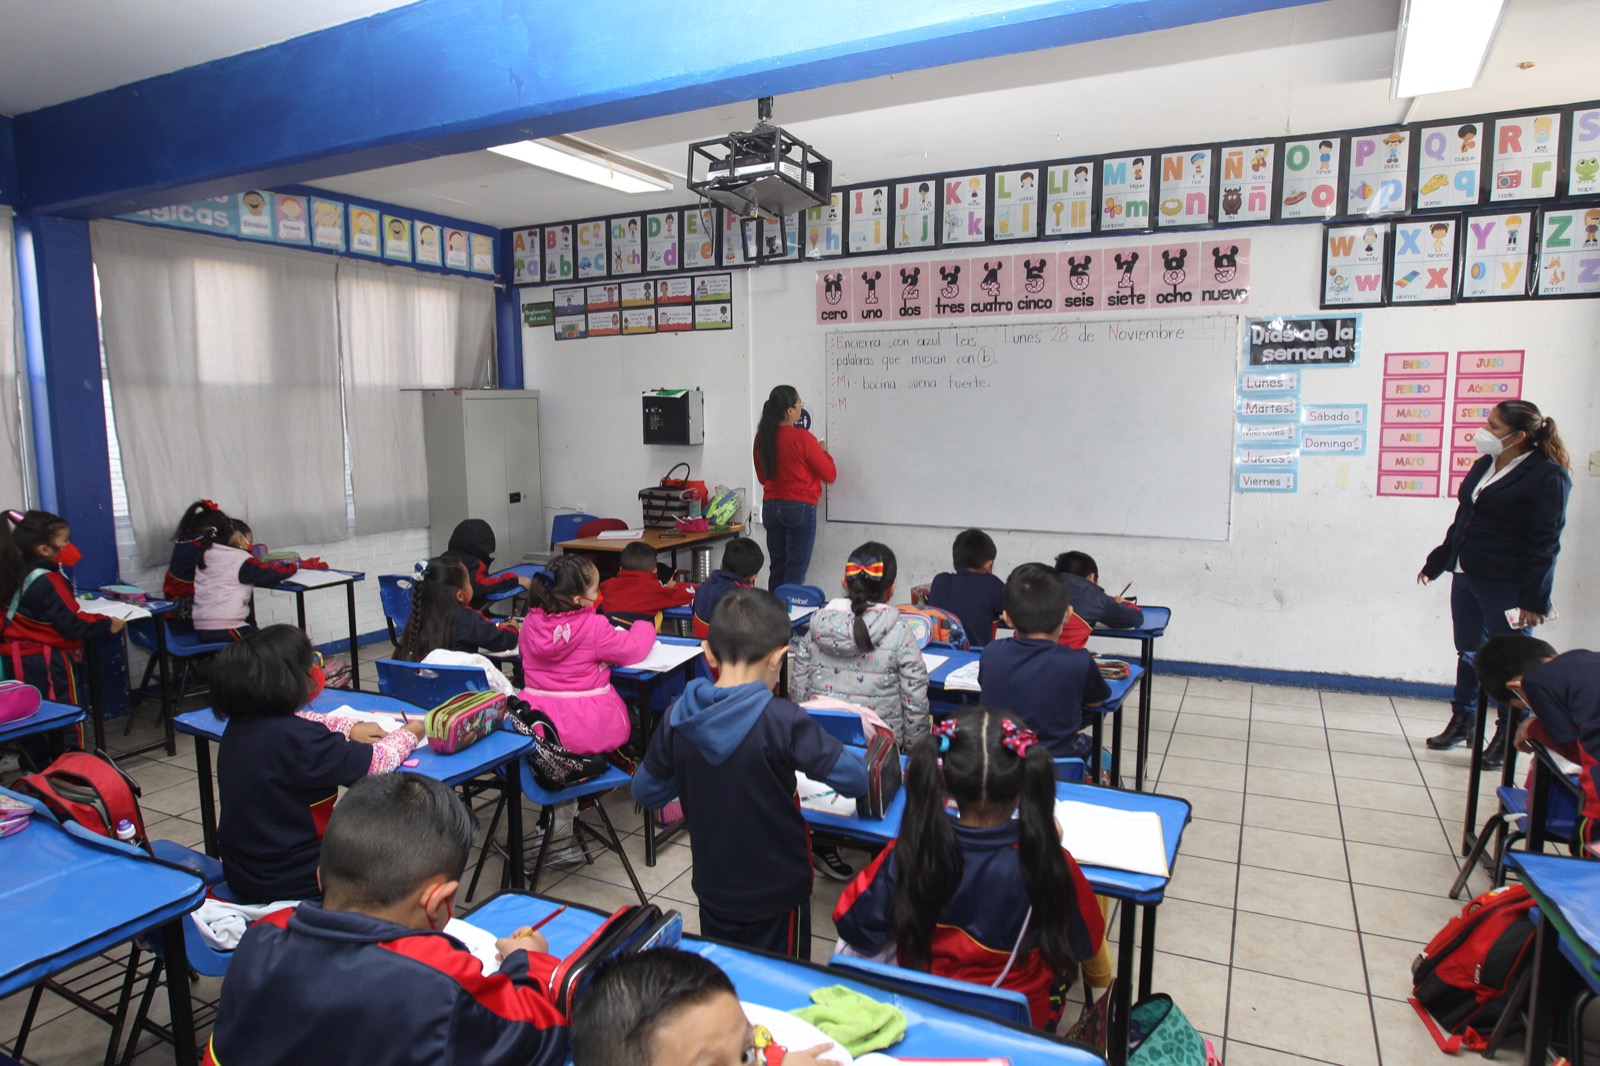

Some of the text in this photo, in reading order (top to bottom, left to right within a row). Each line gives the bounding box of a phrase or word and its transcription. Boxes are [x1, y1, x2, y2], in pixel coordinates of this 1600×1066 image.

[1578, 112, 1600, 142] S
[1425, 132, 1446, 161] Q
[1498, 125, 1522, 154] R
[1224, 150, 1244, 180] Ñ
[1286, 144, 1310, 171] O
[1355, 140, 1375, 167] P
[1104, 162, 1126, 186] M
[1162, 156, 1184, 182] N
[1531, 161, 1552, 188] r
[946, 181, 962, 205] K
[998, 175, 1011, 199] L
[1048, 169, 1069, 195] Ll
[1454, 170, 1476, 197] q
[855, 192, 863, 214] I
[900, 187, 909, 210] J
[1186, 192, 1206, 216] n
[1248, 185, 1267, 211] ñ
[1311, 184, 1335, 208] o
[137, 204, 230, 228] gicas
[727, 210, 736, 231] F
[1071, 200, 1086, 228] ll
[1126, 200, 1148, 218] m
[612, 224, 626, 239] Ch
[648, 217, 661, 238] D
[687, 214, 697, 234] E
[921, 215, 928, 241] j
[968, 211, 982, 235] k
[1546, 215, 1572, 248] Z
[514, 233, 526, 253] A
[547, 230, 556, 249] B
[579, 226, 589, 246] C
[826, 227, 839, 250] h
[1397, 228, 1421, 255] X
[1470, 222, 1496, 250] Y
[626, 250, 640, 265] ch
[664, 242, 676, 266] d
[700, 241, 712, 259] e
[527, 260, 538, 276] a
[560, 254, 571, 276] b
[594, 253, 604, 271] c
[1163, 257, 1185, 285] 8
[1214, 254, 1237, 283] 9
[980, 268, 1000, 296] 4
[1025, 266, 1044, 293] 5
[1069, 263, 1090, 291] 6
[1117, 260, 1136, 288] 7
[825, 281, 842, 304] 0
[865, 278, 878, 304] 1
[902, 274, 919, 300] 2
[941, 273, 960, 299] 3
[821, 310, 848, 320] cero
[862, 309, 883, 319] uno
[899, 299, 921, 317] dos
[936, 298, 965, 314] tres
[971, 296, 1013, 313] cuatro
[1017, 296, 1053, 310] cinco
[1065, 292, 1094, 307] seis
[1107, 286, 1146, 306] siete
[1156, 284, 1192, 304] ocho
[836, 336, 881, 349] Encierra
[916, 332, 941, 346] azul
[1004, 324, 1185, 344] Lunes 28 de Noviembre
[1303, 321, 1328, 342] de
[1335, 320, 1354, 341] la
[836, 353, 874, 371] palabras
[882, 356, 900, 370] que
[911, 355, 946, 365] inician
[957, 356, 975, 365] con
[1262, 346, 1346, 362] semana
[1476, 358, 1504, 368] JULIO
[836, 375, 850, 388] Mi
[863, 375, 896, 390] bocina
[907, 379, 937, 389] suena
[1246, 376, 1283, 389] Lunes
[1468, 383, 1508, 393] AGOSTO
[838, 397, 847, 410] M
[1245, 402, 1289, 414] Martes
[1396, 408, 1431, 418] MARZO
[1461, 408, 1492, 418] SEPTIE
[1309, 410, 1350, 422] Sábado
[1305, 438, 1352, 451] Domingo
[1242, 451, 1285, 464] Jueves
[1395, 456, 1425, 466] MAYO
[1243, 475, 1281, 486] Viernes
